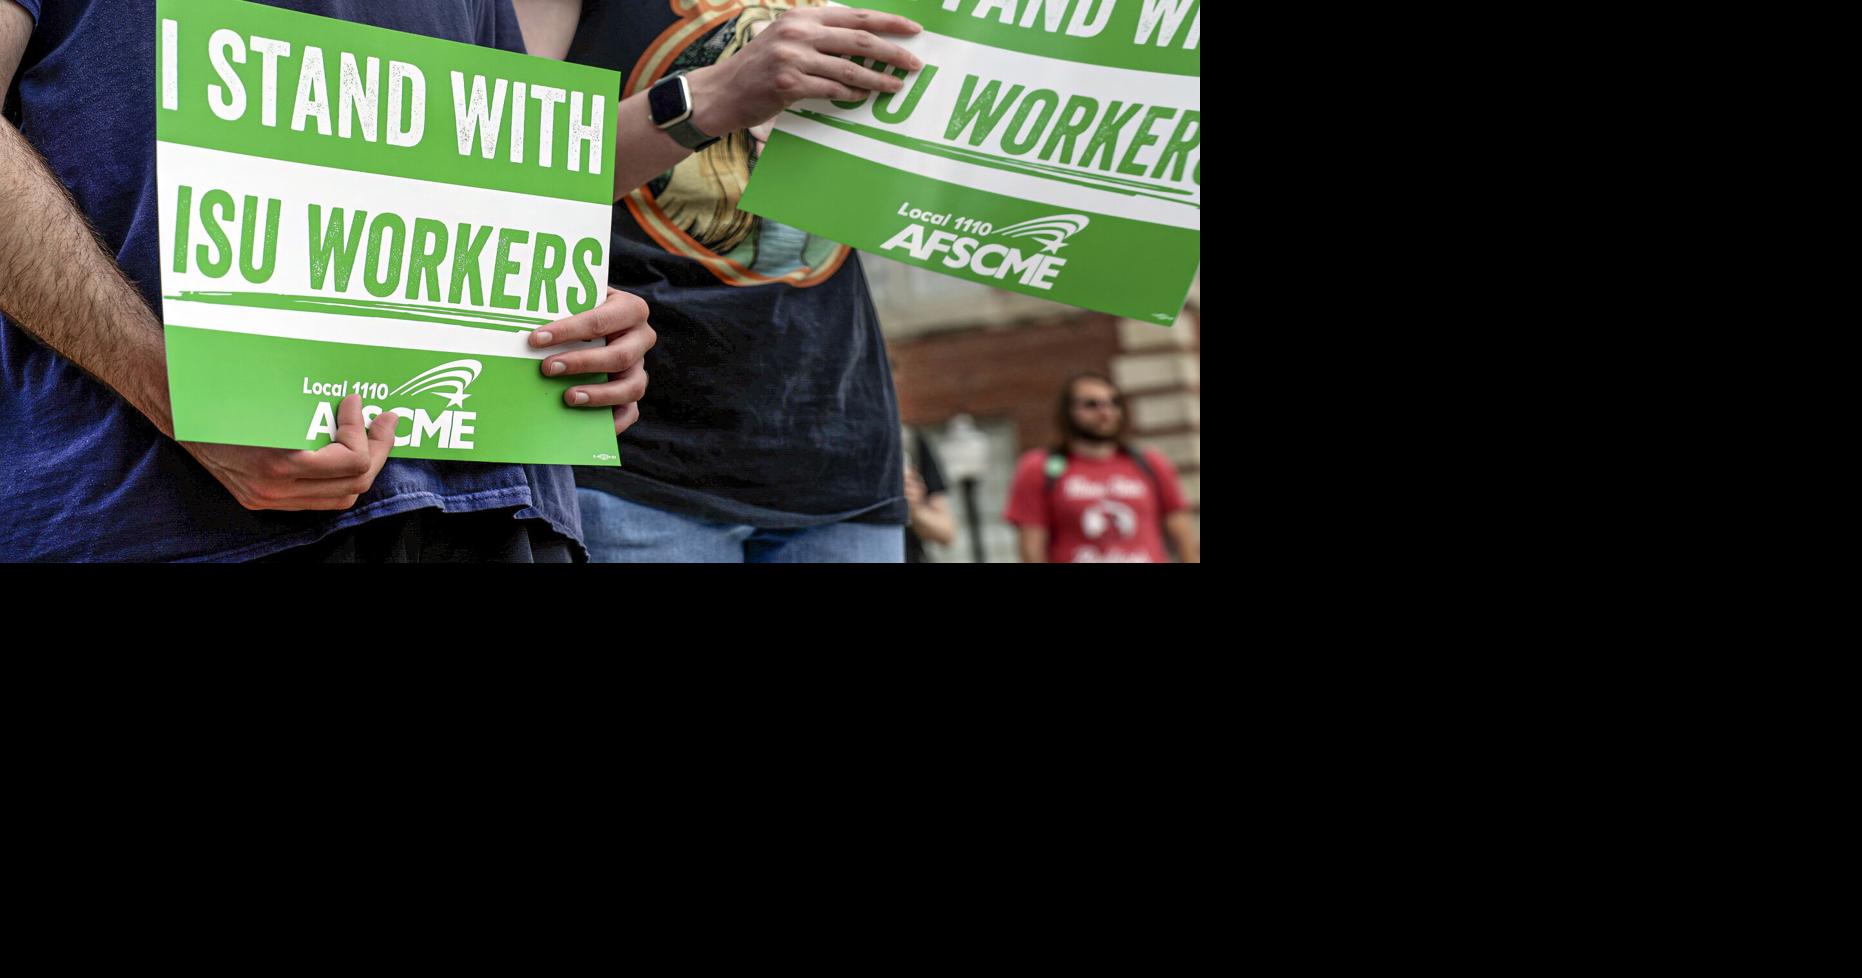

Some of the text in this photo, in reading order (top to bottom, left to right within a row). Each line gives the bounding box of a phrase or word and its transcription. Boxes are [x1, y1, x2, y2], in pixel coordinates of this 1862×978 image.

[162, 18, 606, 175] I STAND WITH
[943, 73, 1200, 186] WORKER
[173, 185, 603, 316] ISU WORKERS
[879, 223, 1067, 290] AFSCME
[897, 202, 993, 237] Local 1110
[302, 376, 389, 400] Local 1110
